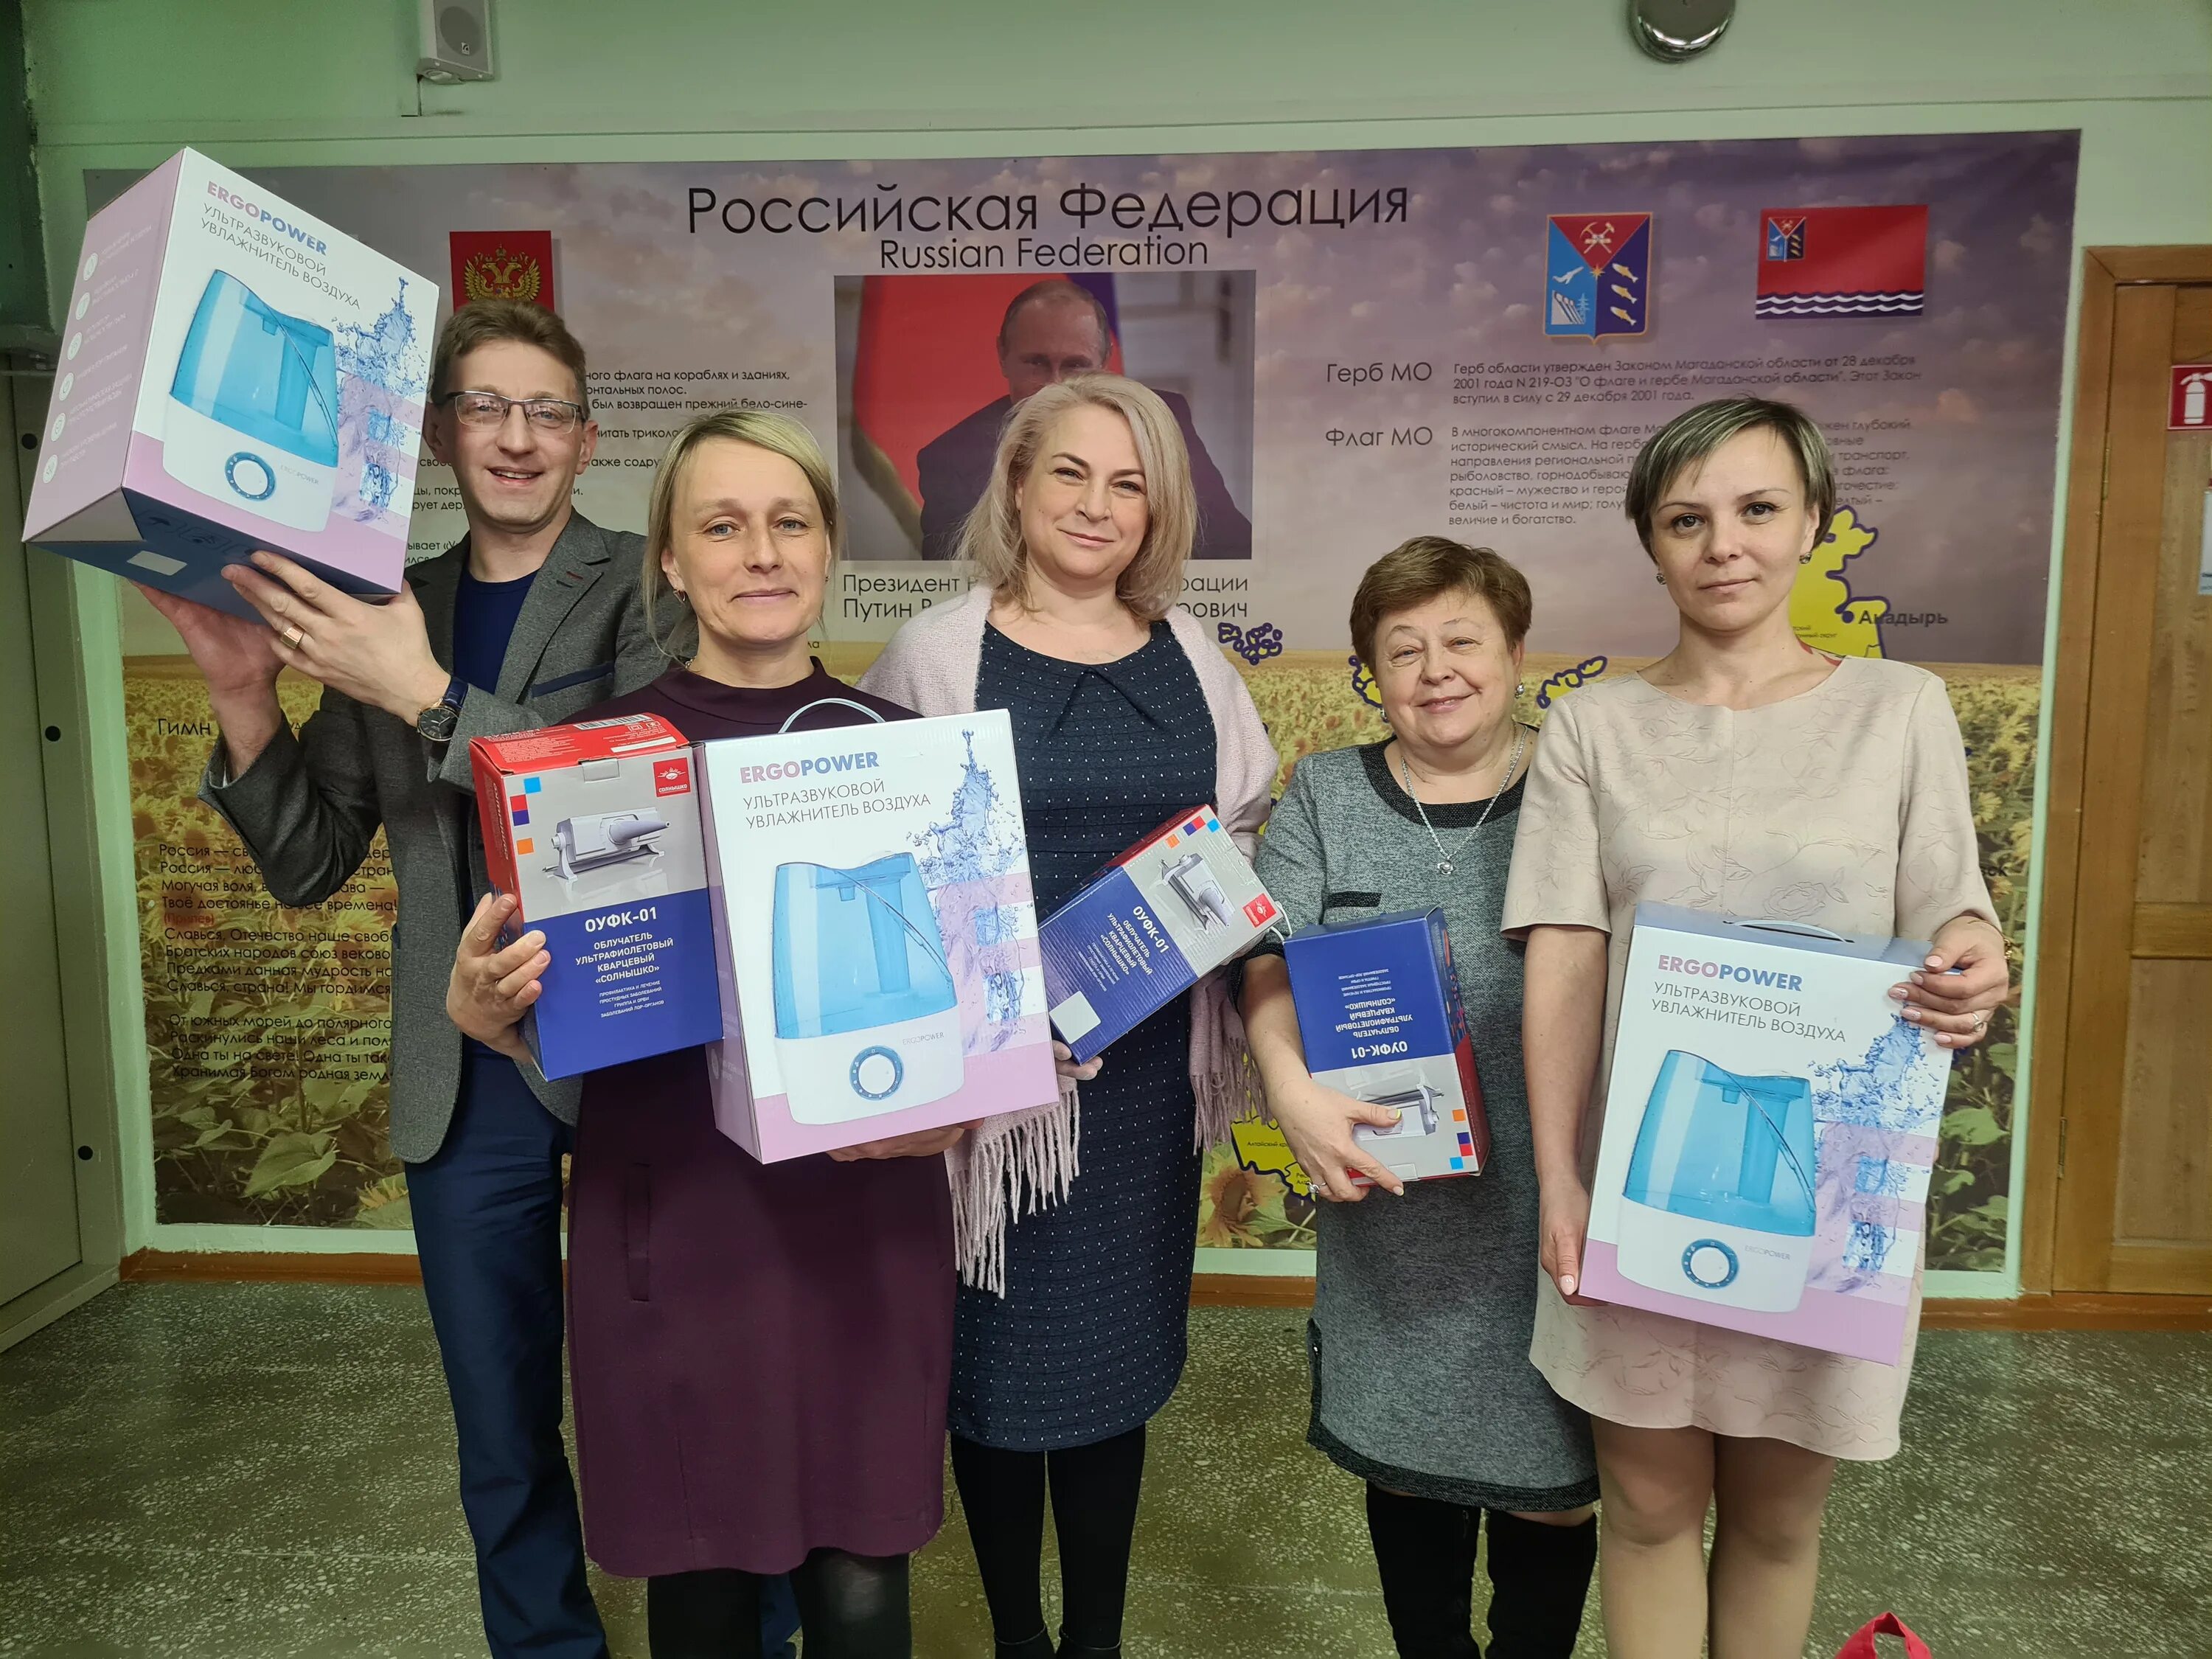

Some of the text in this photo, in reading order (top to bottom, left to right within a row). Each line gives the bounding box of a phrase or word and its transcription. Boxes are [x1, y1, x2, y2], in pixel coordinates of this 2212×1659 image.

[207, 181, 327, 256] ERGOPOWER
[689, 182, 1408, 238] Российская Федерация
[203, 203, 326, 276] УЛЬТРАЗВУКОВОЙ
[881, 234, 1208, 268] Russian Federation
[201, 218, 360, 310] УВЛАЖНИТЕЛЬ ВОЗДУХА
[1326, 361, 1433, 386] Герб МО
[1453, 364, 1485, 377] Герб
[1488, 363, 1540, 375] области
[1544, 361, 1610, 376] утвержден
[1615, 361, 1672, 372] Законом
[1842, 355, 1857, 366] 28
[614, 369, 653, 383] флага
[656, 371, 671, 380] на
[675, 369, 728, 383] кораблях
[732, 372, 739, 380] и
[742, 371, 790, 381] зданиях,
[1453, 378, 1480, 389] 2001
[1484, 379, 1512, 389] года
[1516, 378, 1526, 388] N
[1593, 375, 1635, 389] флаге
[1638, 377, 1647, 386] и
[1650, 374, 1688, 386] гербе
[648, 386, 687, 395] полос.
[1453, 390, 1694, 406] вступил в силу с 29 декабря 2001 года.
[592, 398, 807, 411] был возвращен прежний бело-сине-
[1325, 426, 1433, 447] Флаг МО
[1451, 425, 1641, 437] В многокомпонентном флаге
[1451, 440, 1539, 453] исторический
[1542, 441, 1587, 451] смысл.
[1590, 439, 1607, 451] На
[1451, 454, 1624, 469] направления региональной
[1450, 470, 1532, 484] рыболовство,
[1450, 484, 1503, 497] красный
[1517, 486, 1578, 498] мужество
[1582, 486, 1589, 494] и
[1449, 499, 1488, 511] белый
[1500, 501, 1548, 510] чистота
[1551, 501, 1559, 509] и
[1448, 514, 1576, 526] величие и богатство.
[844, 574, 960, 596] Президент
[844, 598, 912, 623] Путин
[1858, 611, 1948, 627] Анадырь
[158, 718, 211, 735] Гимн
[740, 751, 880, 784] ERGOPOWER
[742, 778, 885, 810] УЛЬТРАЗВУКОВОЙ
[745, 793, 931, 830] УВЛАЖНИТЕЛЬ ВОЗДУХА
[160, 844, 210, 856] Россия
[161, 861, 212, 874] Россия
[161, 879, 257, 893] Могучая воля,
[162, 896, 193, 909] Твоё
[198, 899, 271, 911] достоянье
[327, 900, 397, 913] времена!
[585, 906, 657, 933] ОУФК-01
[164, 928, 226, 942] Славься,
[230, 928, 304, 942] Отечество
[309, 931, 349, 942] наше
[1133, 905, 1169, 953] ОУФК-01
[594, 932, 653, 950] ОБЛУЧАТЕЛЬ
[1107, 913, 1153, 975] УЛЬТРАФИОЛЕТОВЫЙ
[1123, 919, 1150, 958] ОБЛУЧАТЕЛЬ
[166, 945, 230, 959] Братских
[234, 947, 296, 961] народов
[301, 948, 337, 959] союз
[575, 938, 673, 966] УЛЬТРАФИОЛЕТОВЫЙ
[1100, 934, 1130, 975] «СОЛНЫШКО»
[1108, 931, 1137, 968] КВАРЦЕВЫЙ
[167, 962, 372, 978] Предками данная мудрость
[597, 953, 655, 973] КВАРЦЕВЫЙ
[595, 965, 660, 984] «СОЛНЫШКО»
[1658, 954, 1802, 992] ERGOPOWER
[167, 979, 391, 997] Славься, страна! Мы гордимся
[1345, 998, 1396, 1010] «СОЛНЫШКО»
[1654, 981, 1801, 1017] УЛЬТРАЗВУКОВОЙ
[1349, 1006, 1395, 1020] КВАРЦЕВЫЙ
[1652, 998, 1846, 1043] УВЛАЖНИТЕЛЬ ВОЗДУХА
[170, 1014, 392, 1032] От южных морей до полярного
[1335, 1014, 1413, 1032] УЛЬТРАФИОЛЕТОВЫЙ
[1353, 1026, 1399, 1038] ОБЛУЧАТЕЛЬ
[170, 1032, 262, 1046] Раскинулись
[267, 1035, 306, 1046] наши
[310, 1036, 345, 1046] леса
[350, 1037, 358, 1046] и
[171, 1048, 209, 1062] Одна
[213, 1051, 229, 1060] ты
[234, 1051, 251, 1061] на
[257, 1051, 299, 1062] свете!
[304, 1050, 342, 1064] Одна
[346, 1053, 361, 1063] ты
[1351, 1040, 1408, 1059] ОУФК-01
[172, 1065, 246, 1080] Хранимая
[250, 1067, 294, 1079] Богом
[299, 1069, 350, 1082] родная
